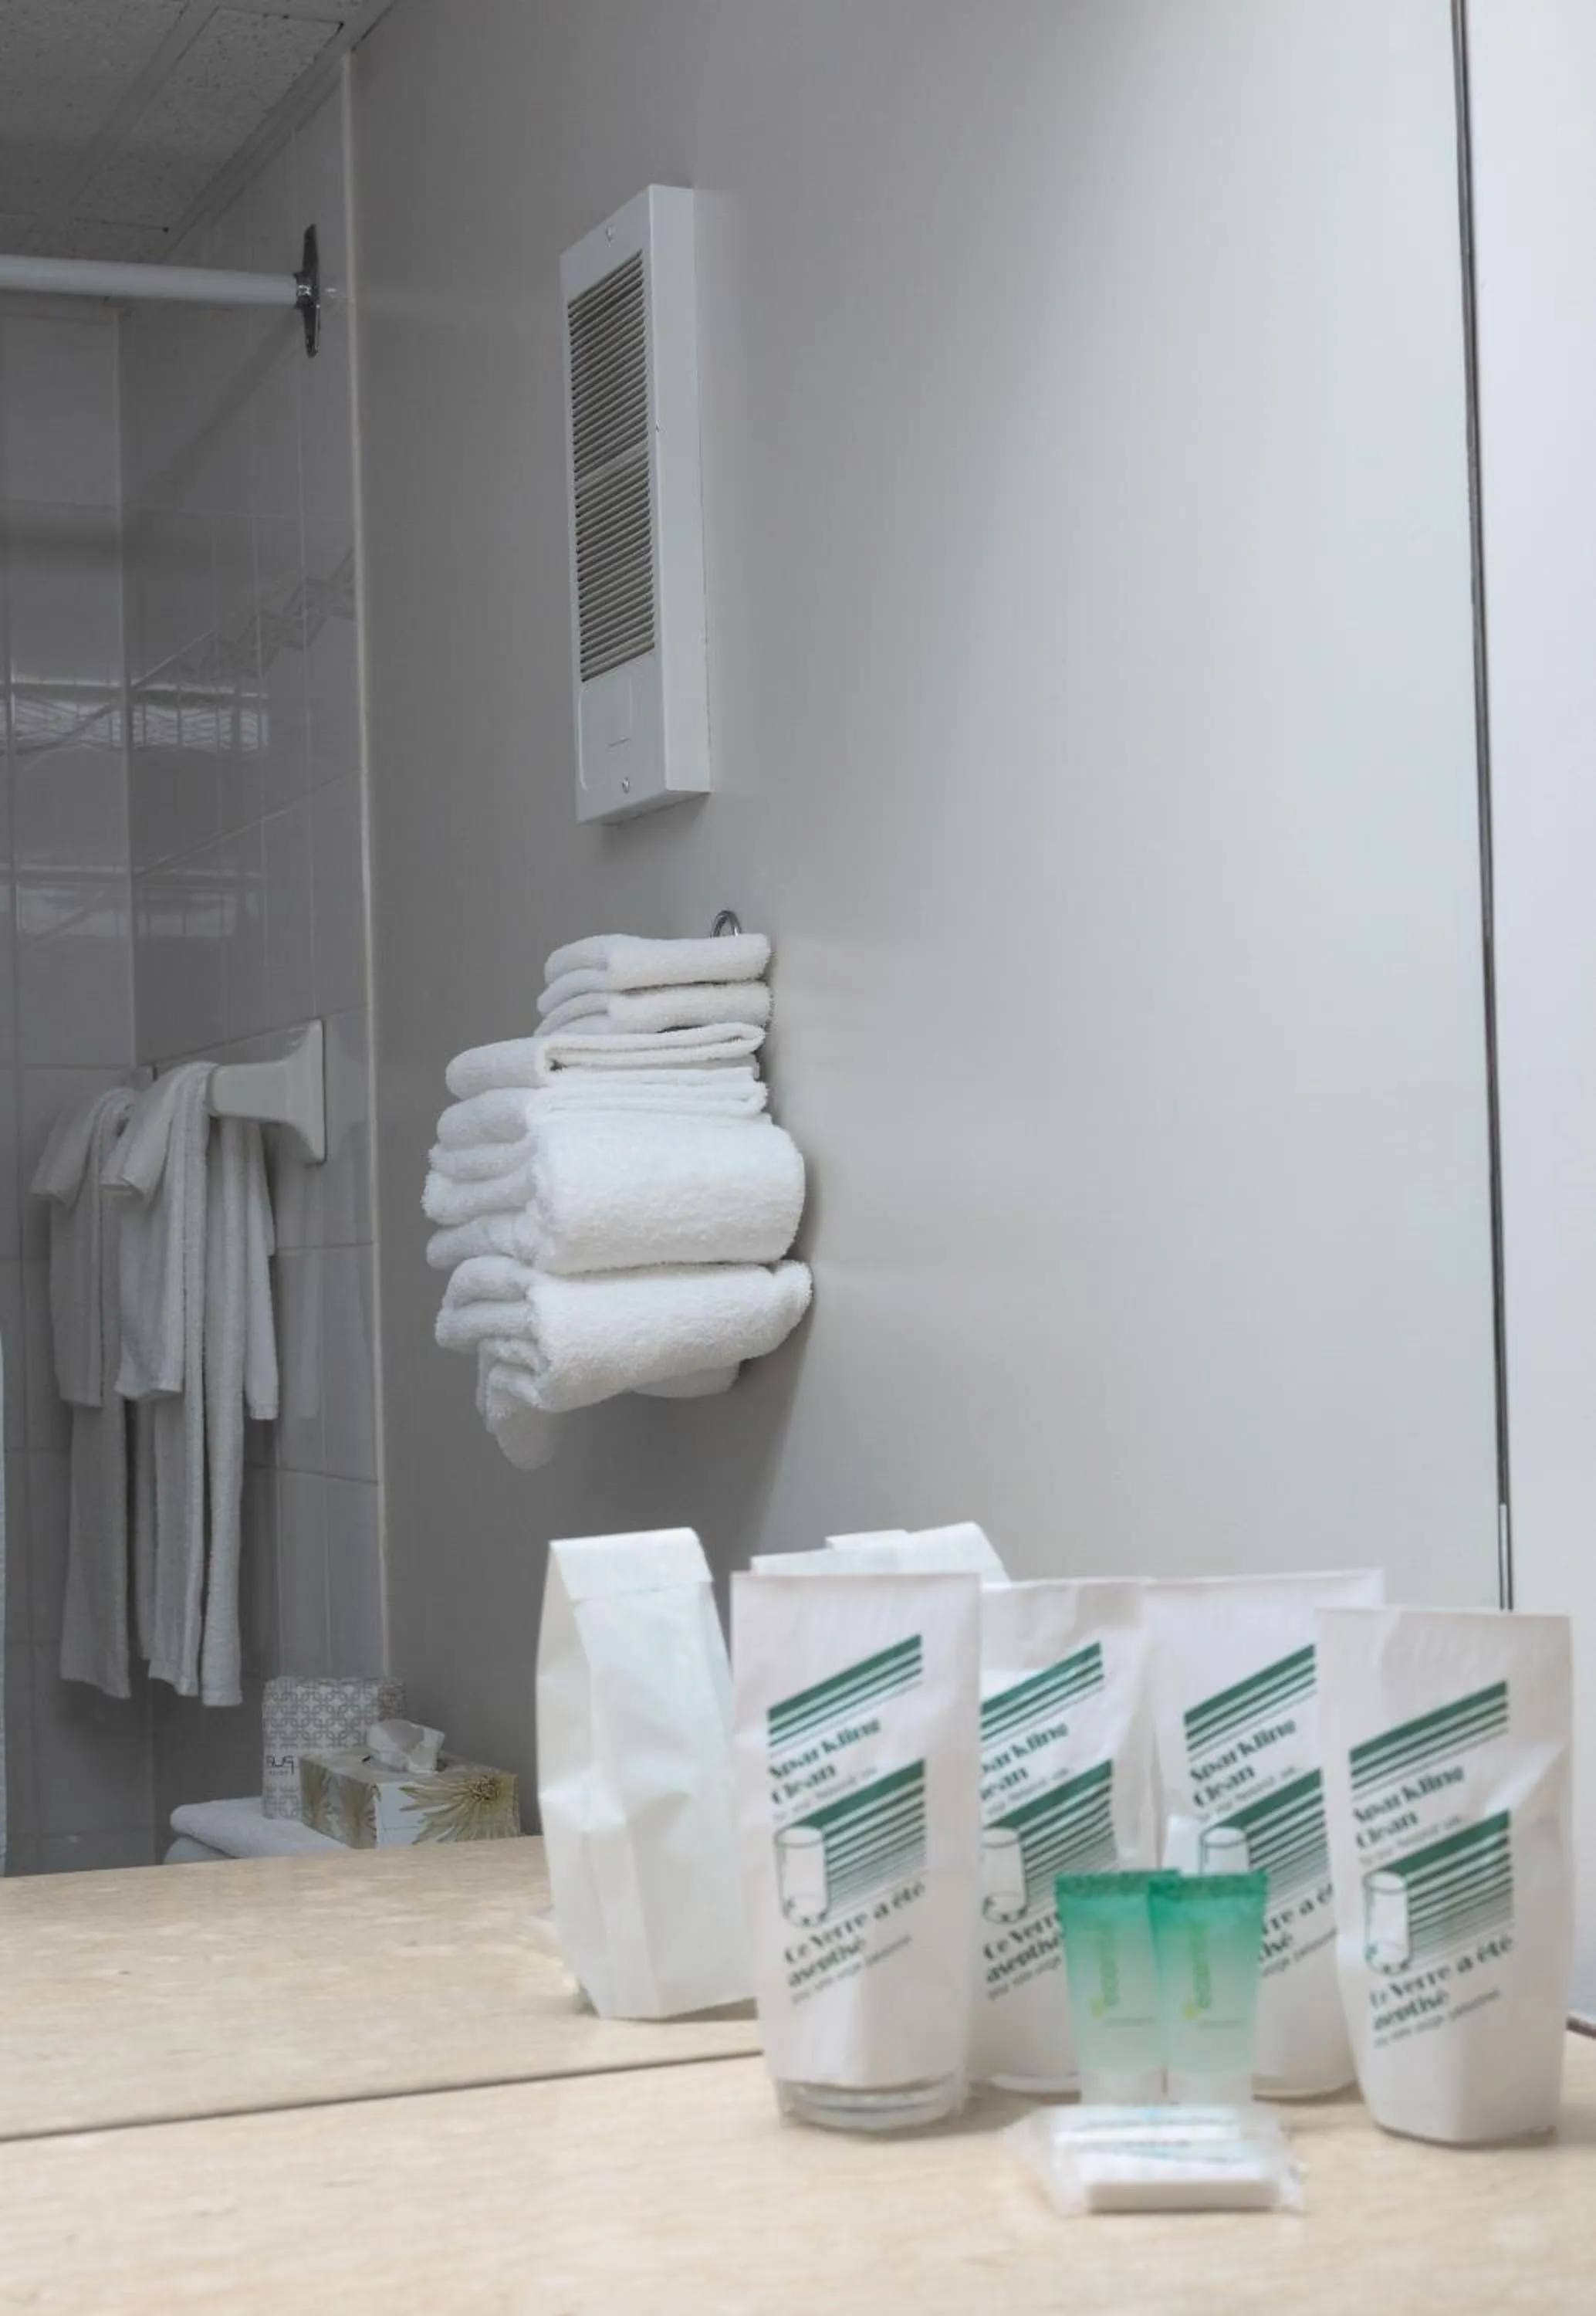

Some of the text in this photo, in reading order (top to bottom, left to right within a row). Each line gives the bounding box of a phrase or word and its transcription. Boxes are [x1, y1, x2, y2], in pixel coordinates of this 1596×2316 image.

[1189, 1718, 1297, 1782] Sparkling
[772, 1764, 837, 1805] Clean
[1193, 1765, 1256, 1807] Clean
[1356, 1811, 1418, 1849] Clean
[810, 1911, 868, 1949] Verre
[873, 1902, 890, 1920] a
[892, 1879, 926, 1909] été
[1389, 1966, 1451, 1996] Verre
[1456, 1955, 1474, 1974] a
[1476, 1932, 1513, 1963] été
